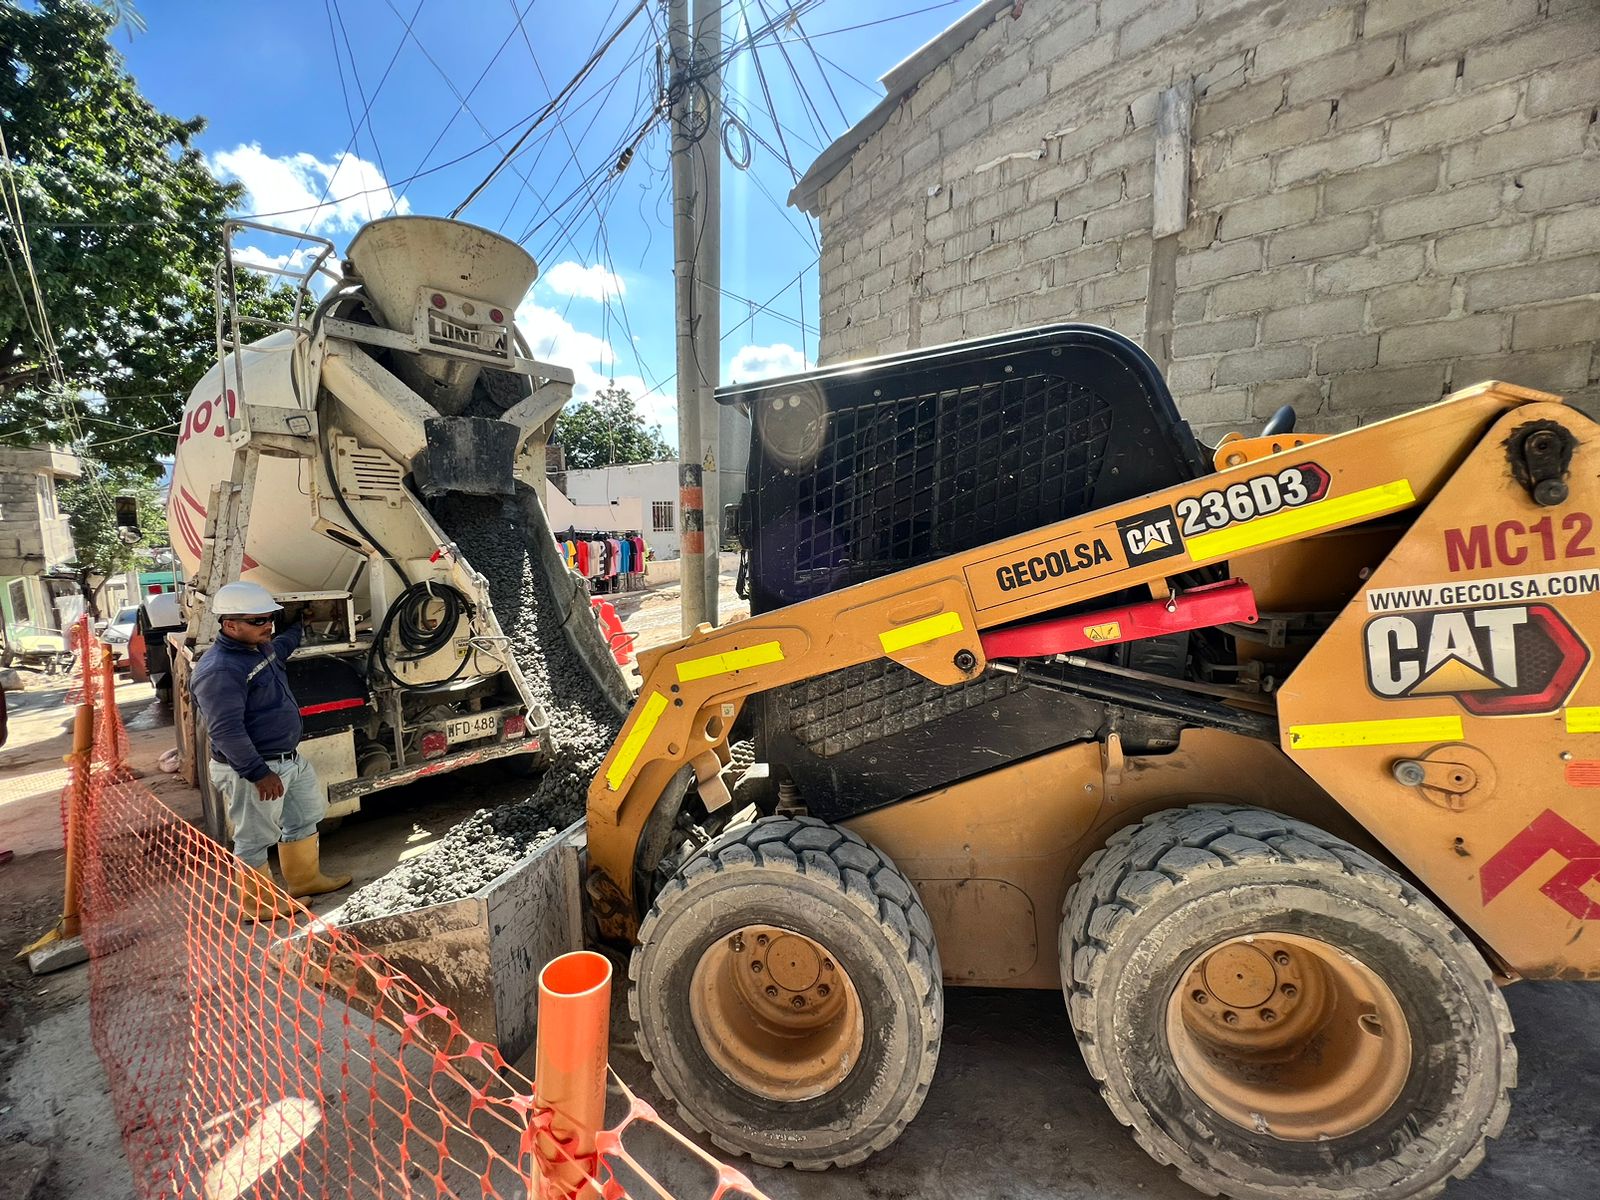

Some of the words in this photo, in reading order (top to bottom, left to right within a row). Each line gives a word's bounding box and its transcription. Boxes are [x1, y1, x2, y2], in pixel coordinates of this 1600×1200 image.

[995, 539, 1112, 591] GECOLSA
[1126, 519, 1172, 555] CAT
[1177, 468, 1308, 536] 236D3
[1444, 512, 1595, 572] MC12
[1370, 573, 1600, 610] WWW.GECOLSA.COM
[1367, 607, 1528, 695] CAT
